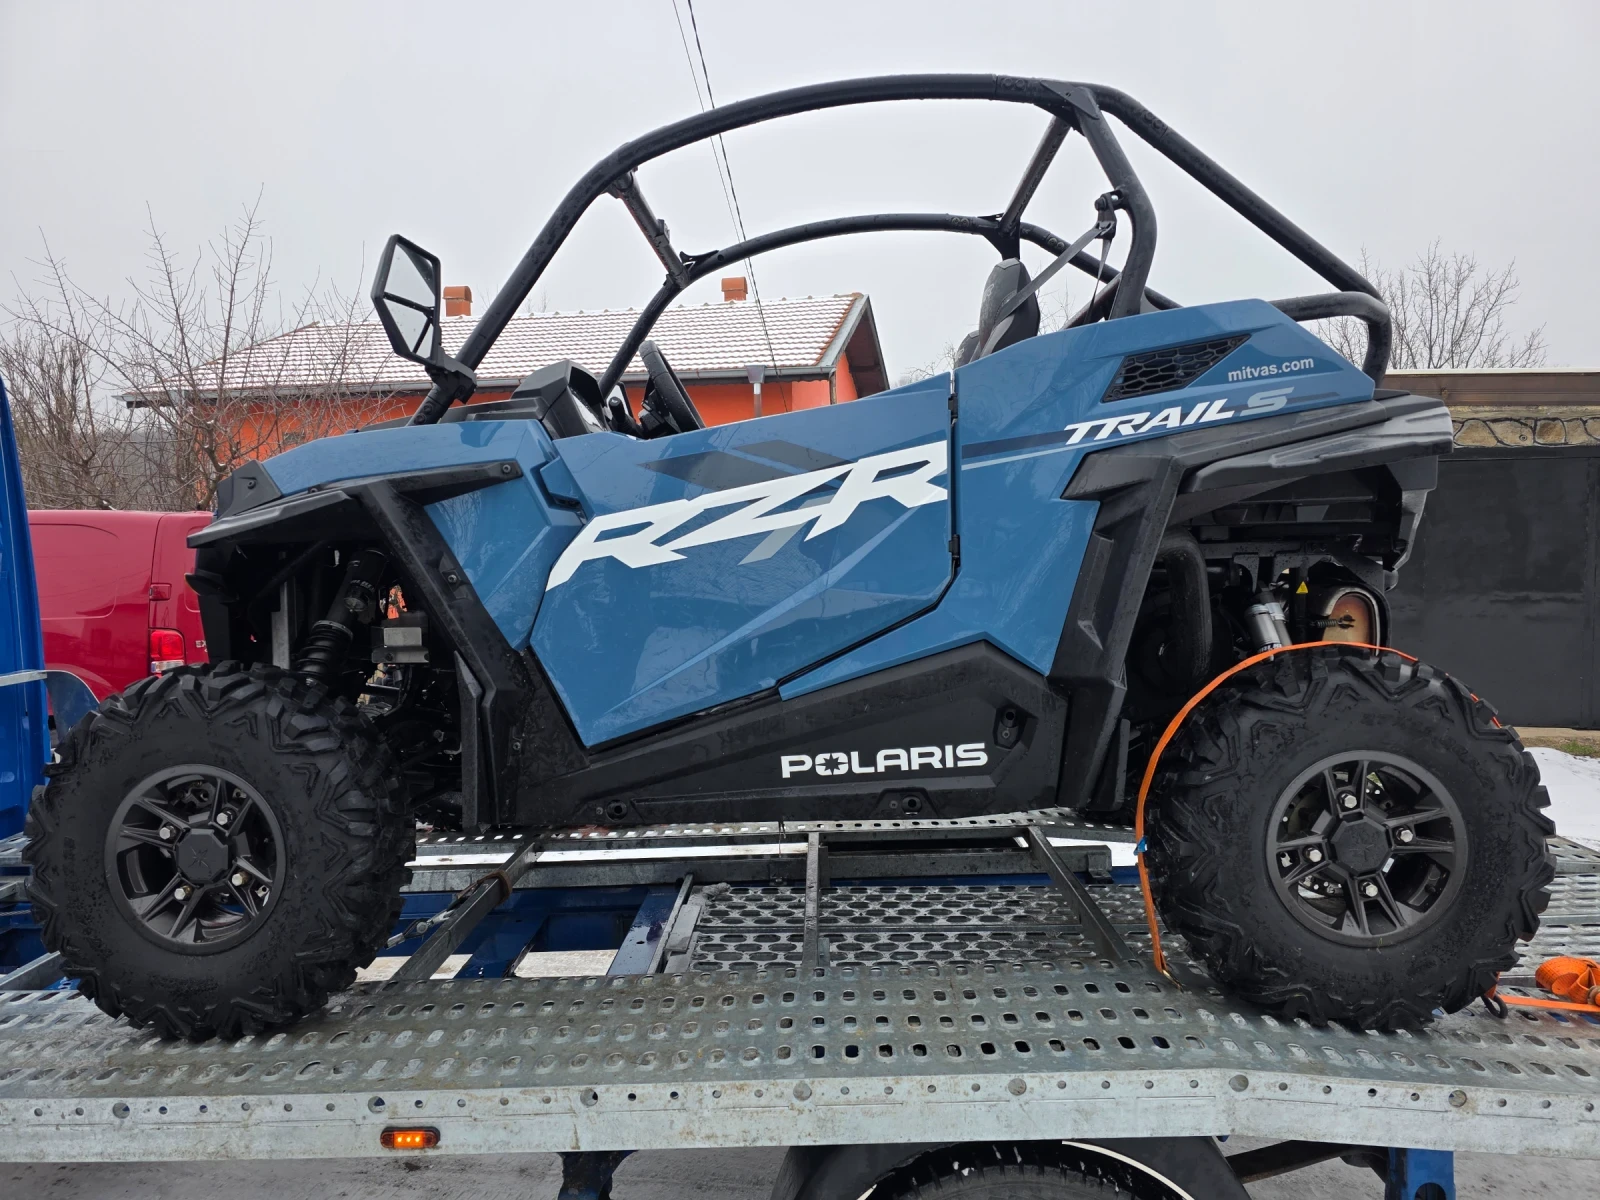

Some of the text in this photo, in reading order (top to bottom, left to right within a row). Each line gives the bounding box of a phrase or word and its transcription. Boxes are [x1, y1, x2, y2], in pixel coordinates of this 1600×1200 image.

[1228, 358, 1314, 382] mitvas.com
[1064, 386, 1295, 445] TRAIL S
[545, 440, 948, 592] RZR
[780, 742, 989, 779] POLARIS
